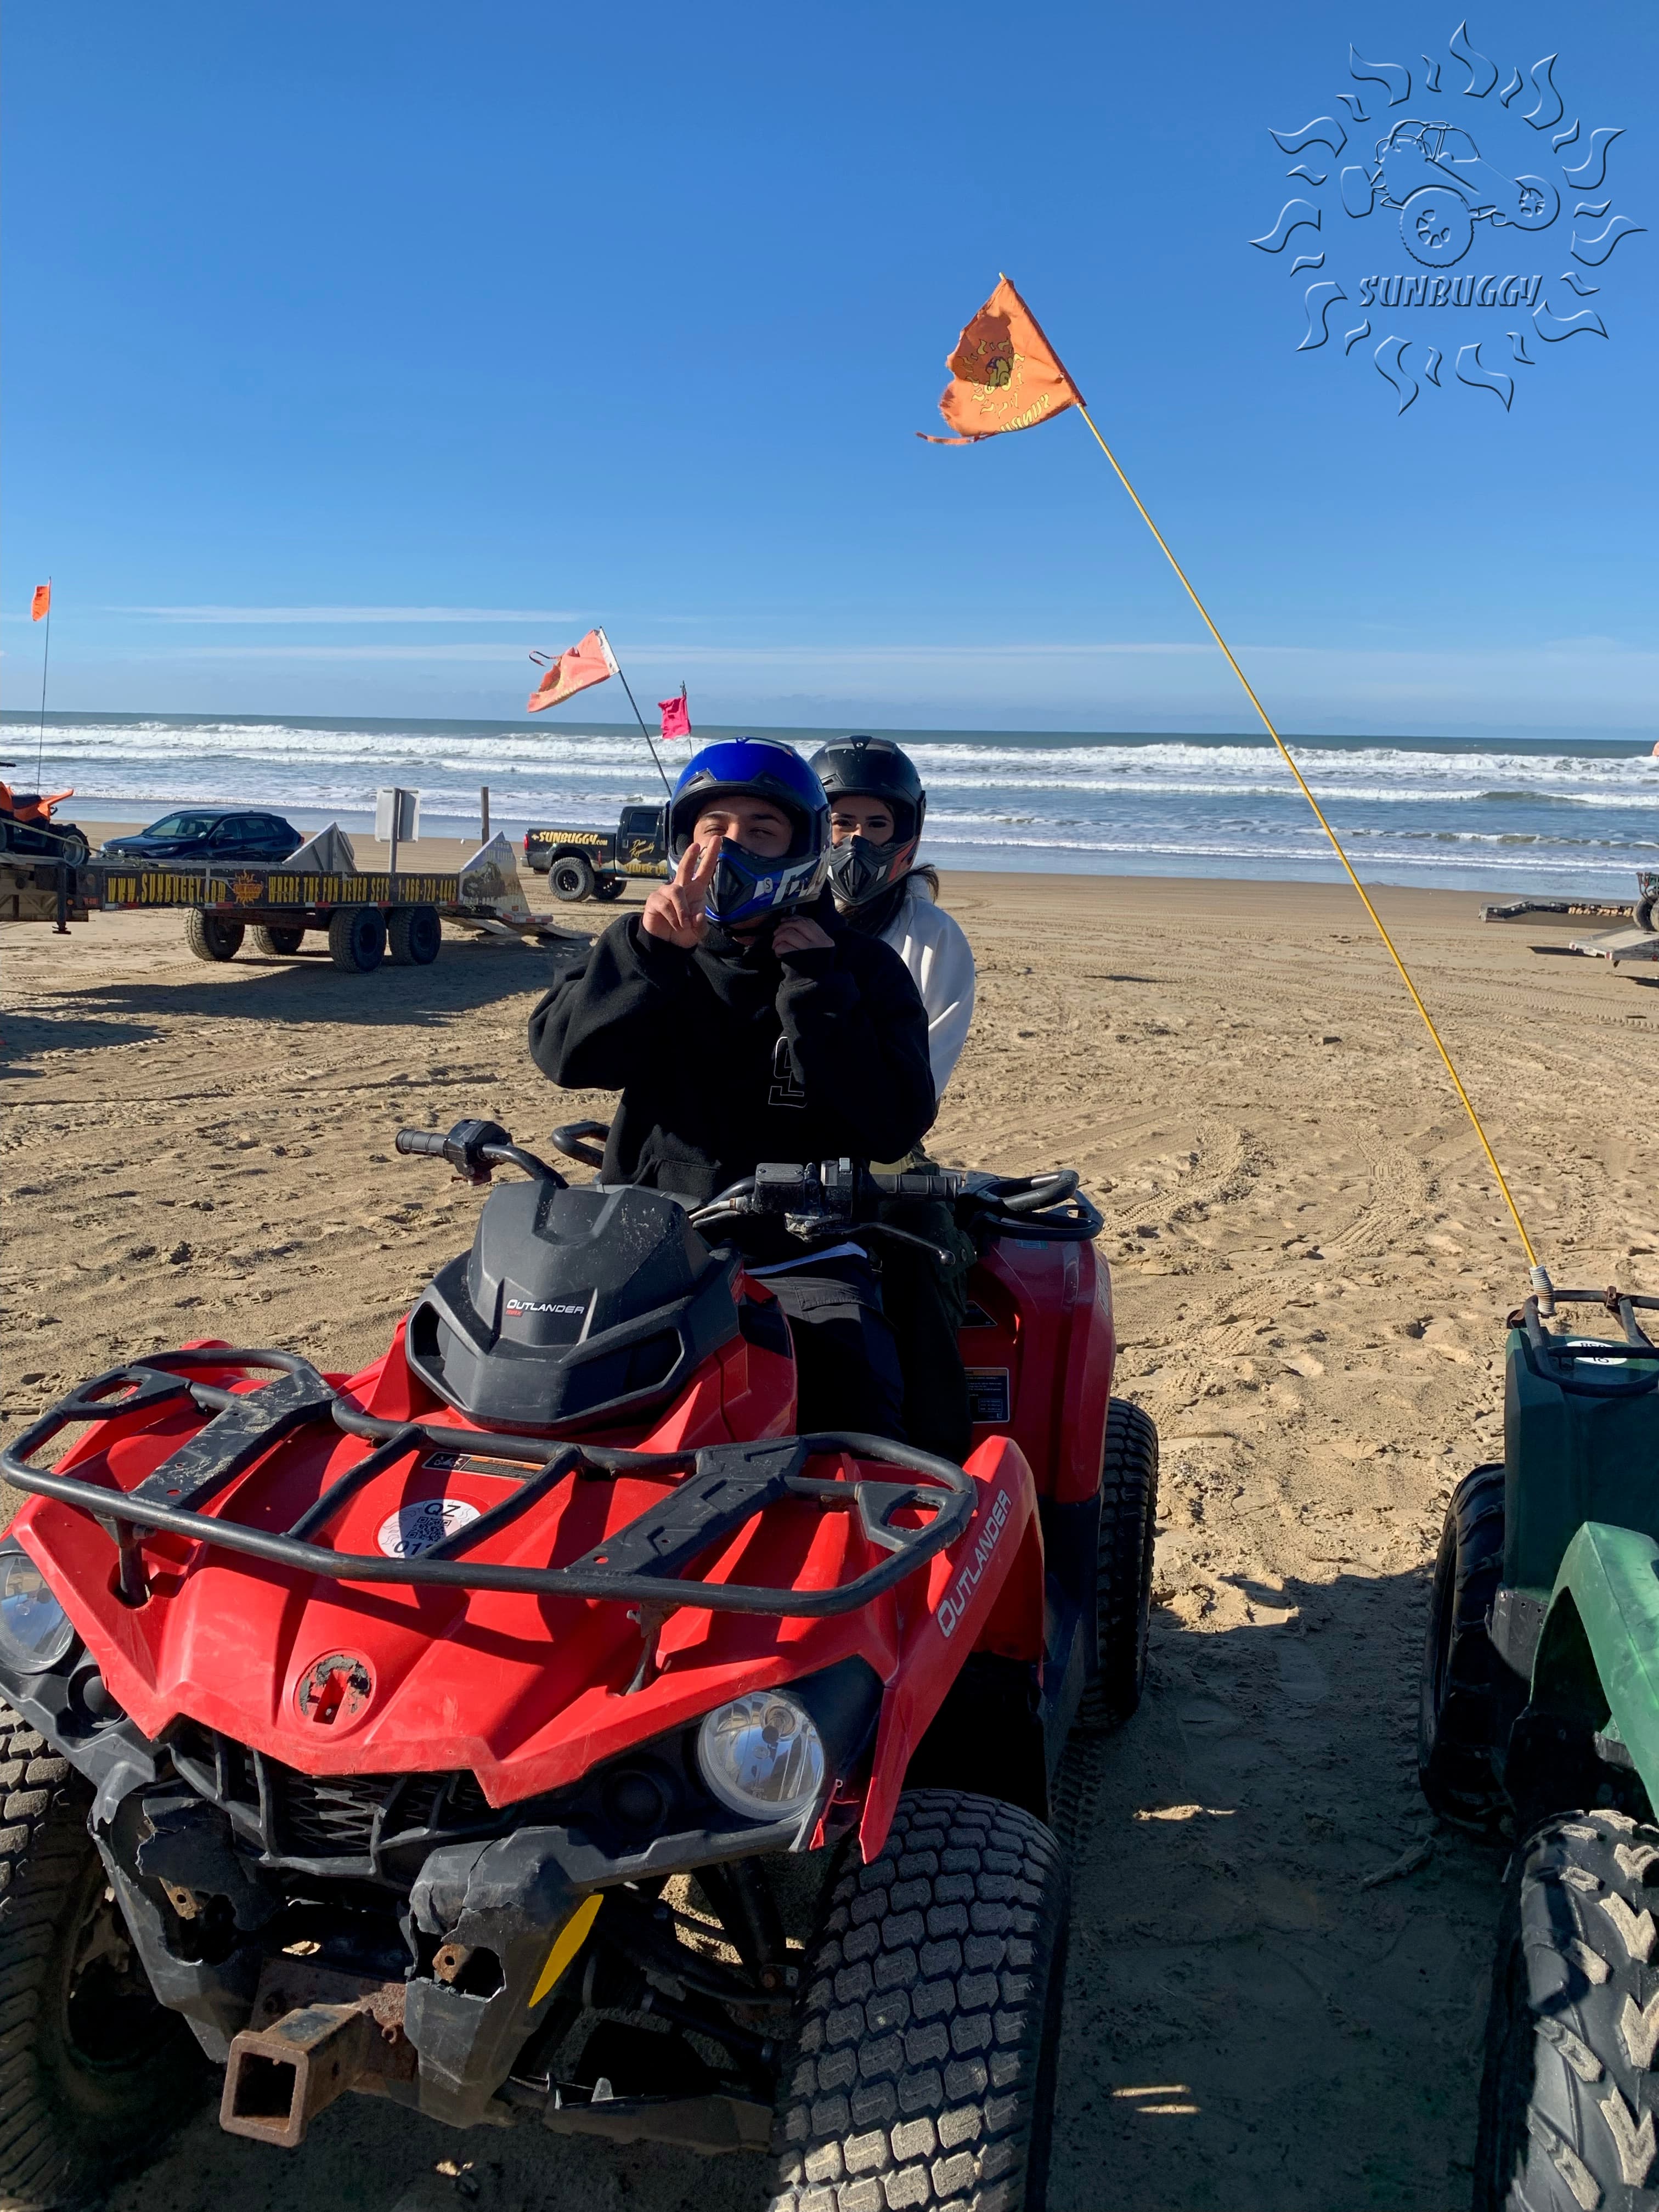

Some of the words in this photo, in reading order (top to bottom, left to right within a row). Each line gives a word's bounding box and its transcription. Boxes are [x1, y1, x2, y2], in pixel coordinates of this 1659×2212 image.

[268, 877, 300, 902] WHERE
[303, 877, 319, 902] THE
[323, 877, 338, 902] FUN
[342, 877, 367, 902] NEVER
[371, 877, 390, 901] SETS
[506, 1299, 585, 1314] OUTLANDER
[424, 1502, 461, 1517] QZ
[937, 1489, 1012, 1638] OUTLANDER
